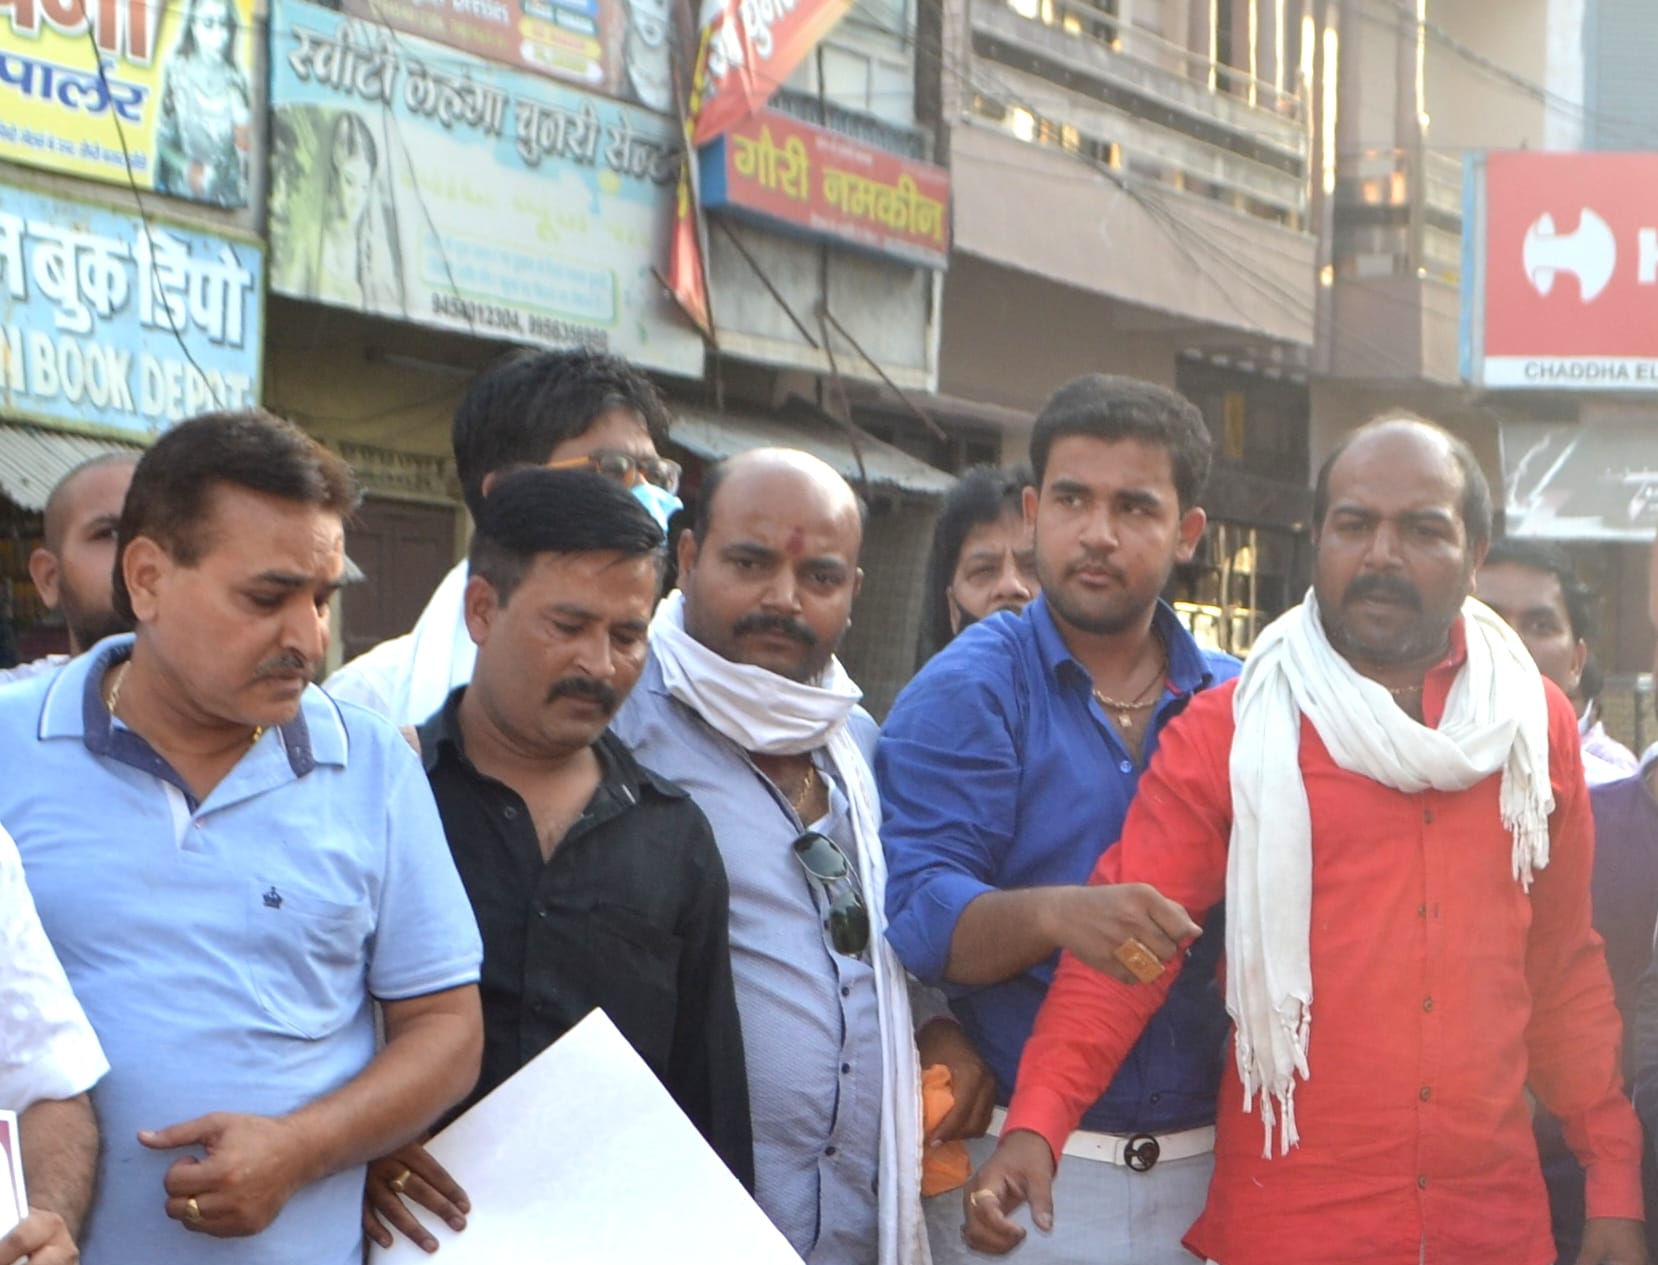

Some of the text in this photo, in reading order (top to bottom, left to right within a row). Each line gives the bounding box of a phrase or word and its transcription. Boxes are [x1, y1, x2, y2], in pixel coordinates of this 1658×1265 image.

[732, 124, 811, 201] गौरी
[821, 170, 945, 243] नमकीन
[25, 218, 132, 337] बुक
[131, 224, 255, 349] डिपो
[29, 330, 137, 417] BOOK
[139, 351, 251, 424] DEPOT
[1524, 361, 1630, 382] CHADDHA
